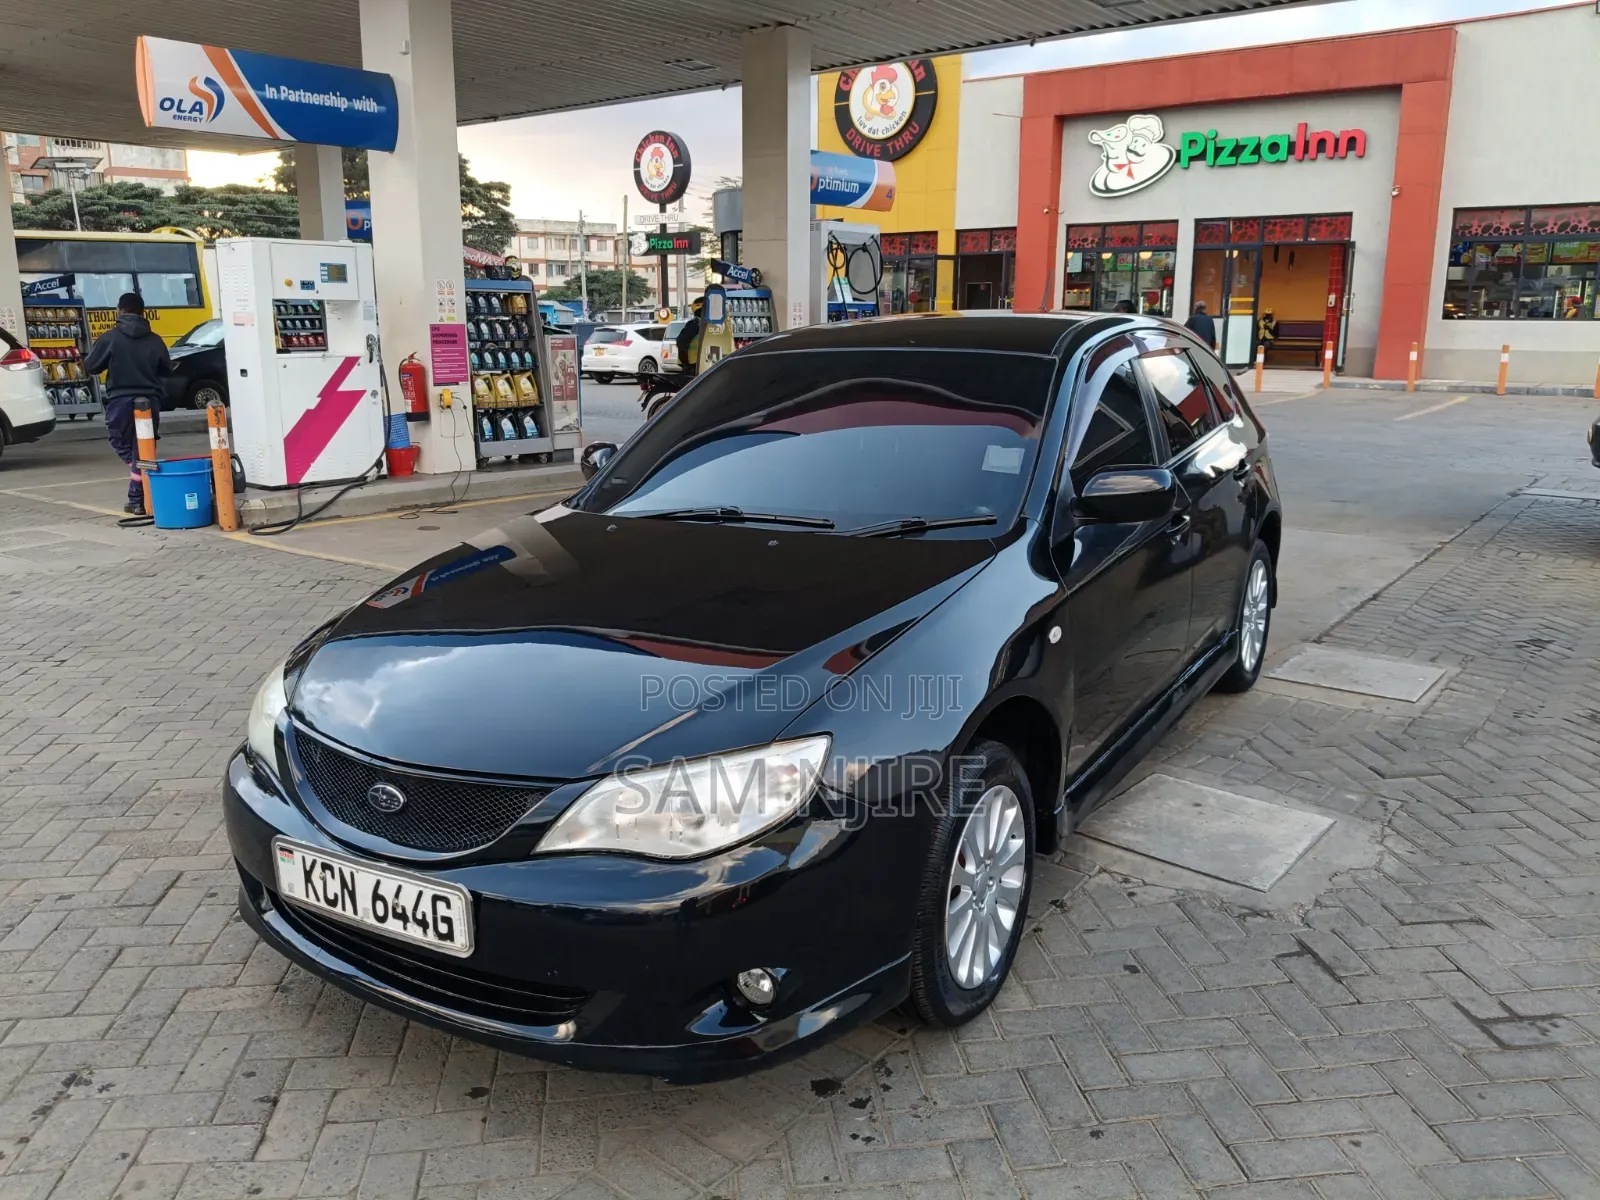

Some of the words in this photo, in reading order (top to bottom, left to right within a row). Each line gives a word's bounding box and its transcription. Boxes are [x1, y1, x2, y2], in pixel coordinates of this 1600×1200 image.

[158, 96, 204, 116] OLA
[264, 83, 278, 100] In
[280, 85, 349, 110] Partnership
[351, 96, 379, 114] with
[172, 114, 204, 124] ENERGY
[881, 110, 908, 136] chicken
[635, 133, 666, 163] Chicken
[665, 135, 679, 160] Inn
[845, 127, 882, 158] DRIVE
[885, 120, 922, 155] THRU
[639, 182, 660, 201] DRIVE
[660, 181, 678, 200] THRU
[885, 188, 894, 200] 4
[639, 214, 660, 224] DRIVE
[660, 213, 679, 222] THRU
[726, 265, 749, 280] Accel
[34, 278, 60, 292] Accel
[86, 310, 118, 323] THOLI
[301, 854, 359, 917] KCN
[371, 878, 455, 943] 644G
